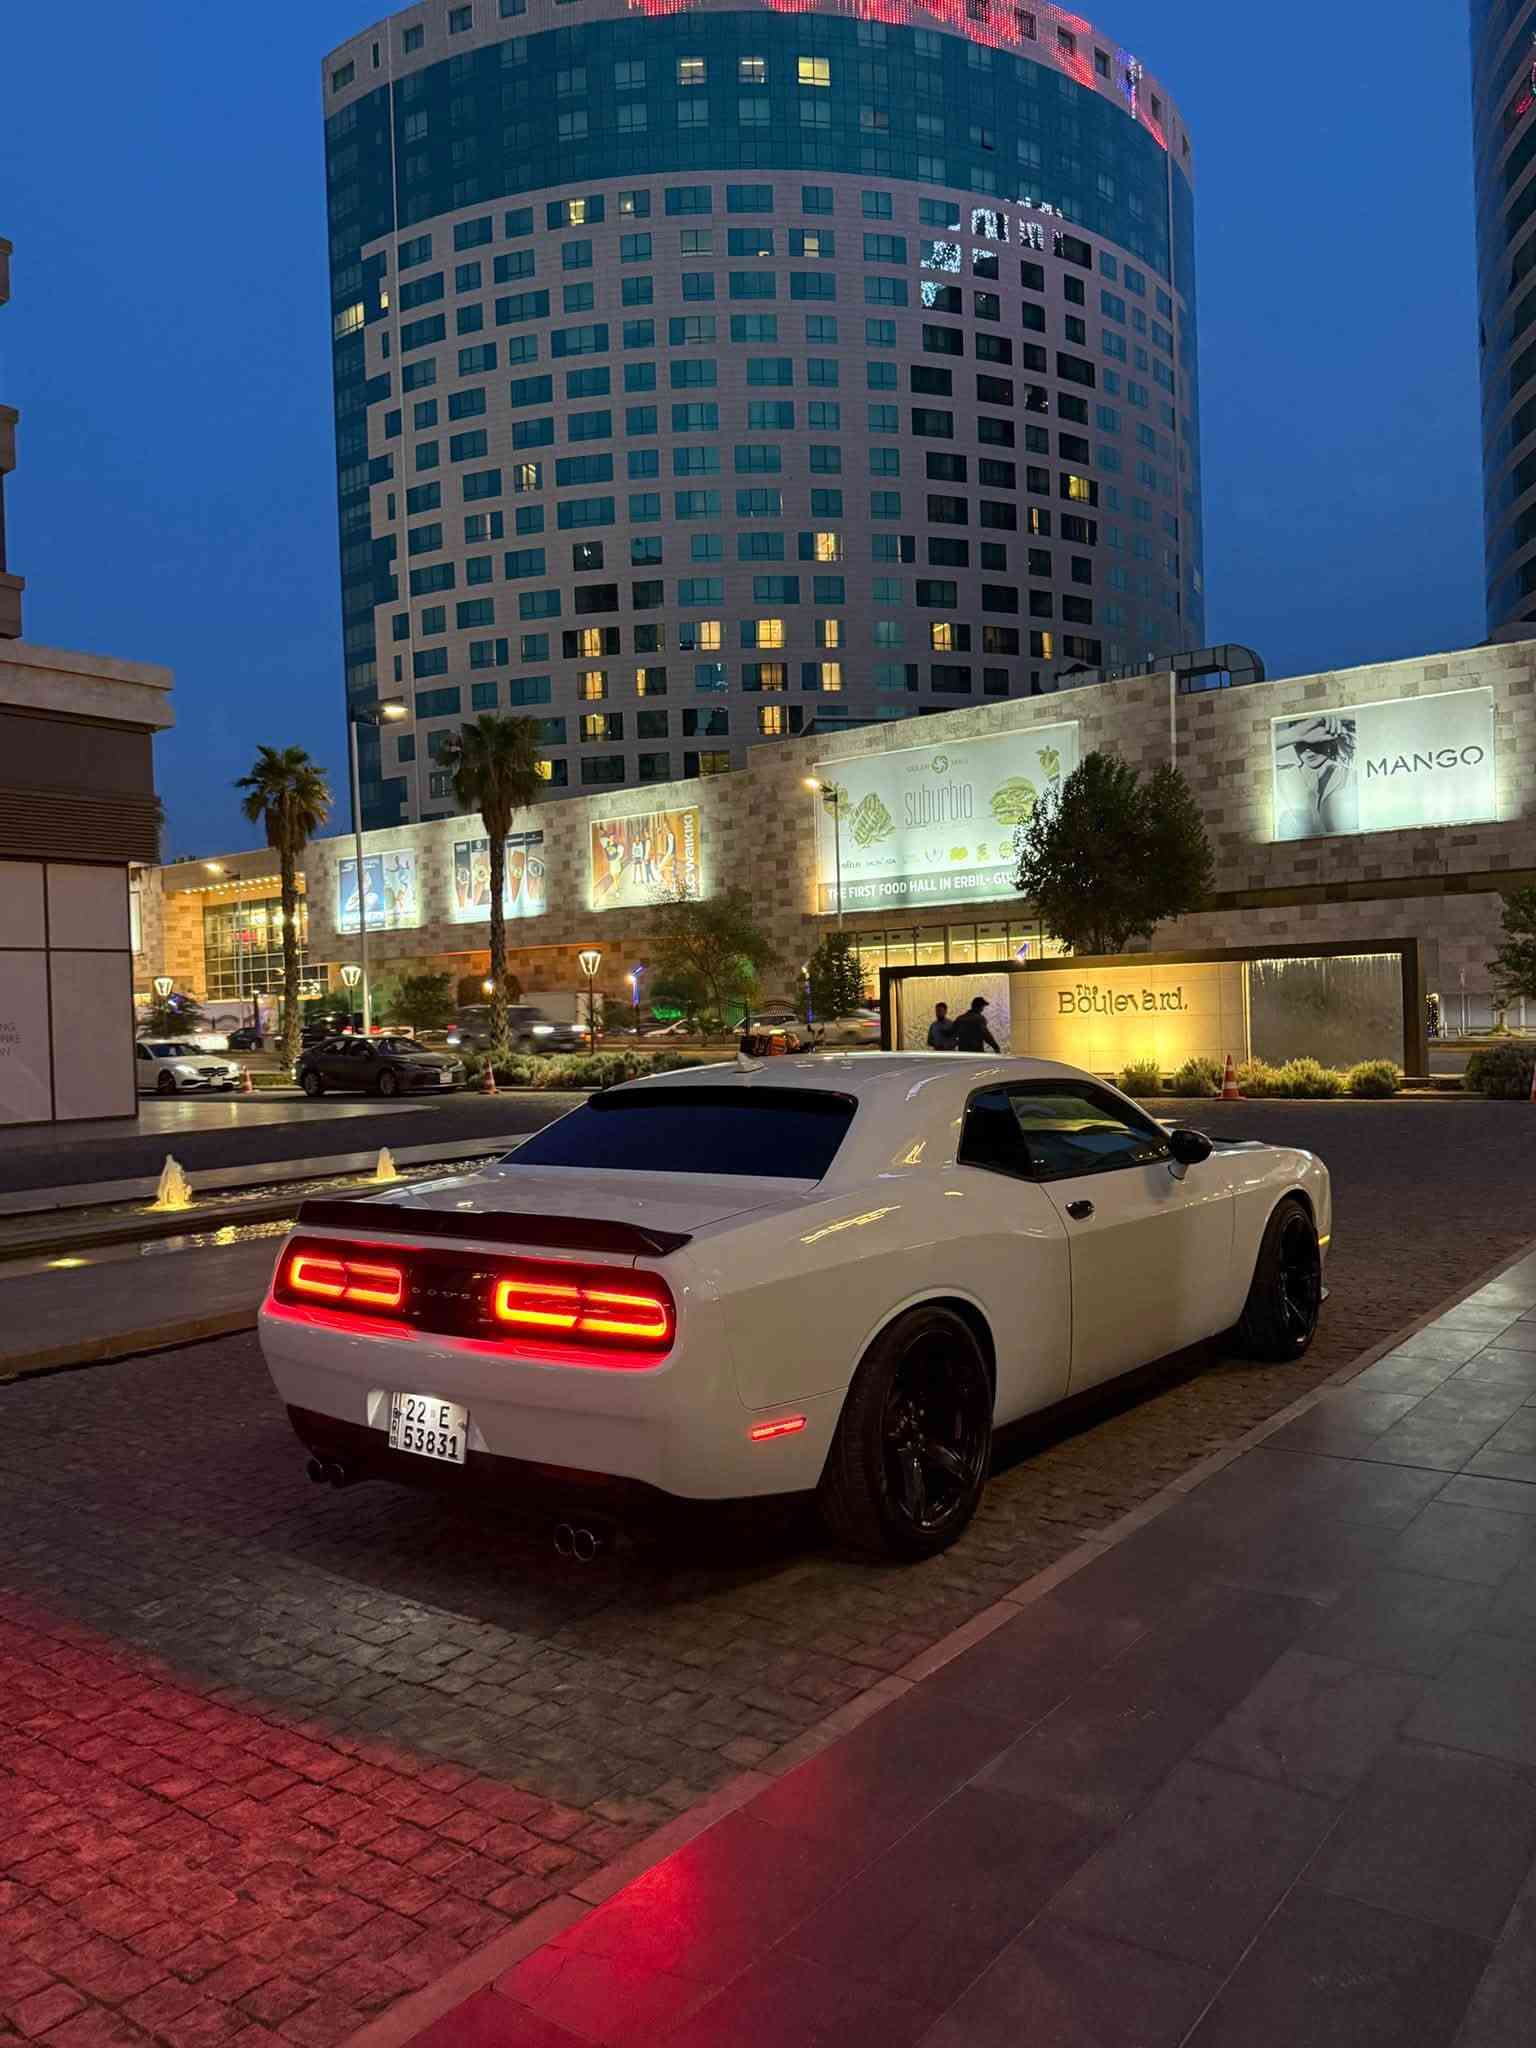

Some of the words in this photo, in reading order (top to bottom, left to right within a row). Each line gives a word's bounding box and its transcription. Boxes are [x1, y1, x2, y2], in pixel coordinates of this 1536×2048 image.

[1366, 745, 1484, 778] MANGO
[848, 885, 876, 898] FIRST
[879, 882, 907, 895] FOOD
[909, 878, 937, 892] HALL
[940, 876, 951, 890] IN
[1076, 984, 1098, 996] The
[405, 1398, 426, 1424] 22
[439, 1405, 450, 1429] E
[403, 1425, 459, 1458] 53831
